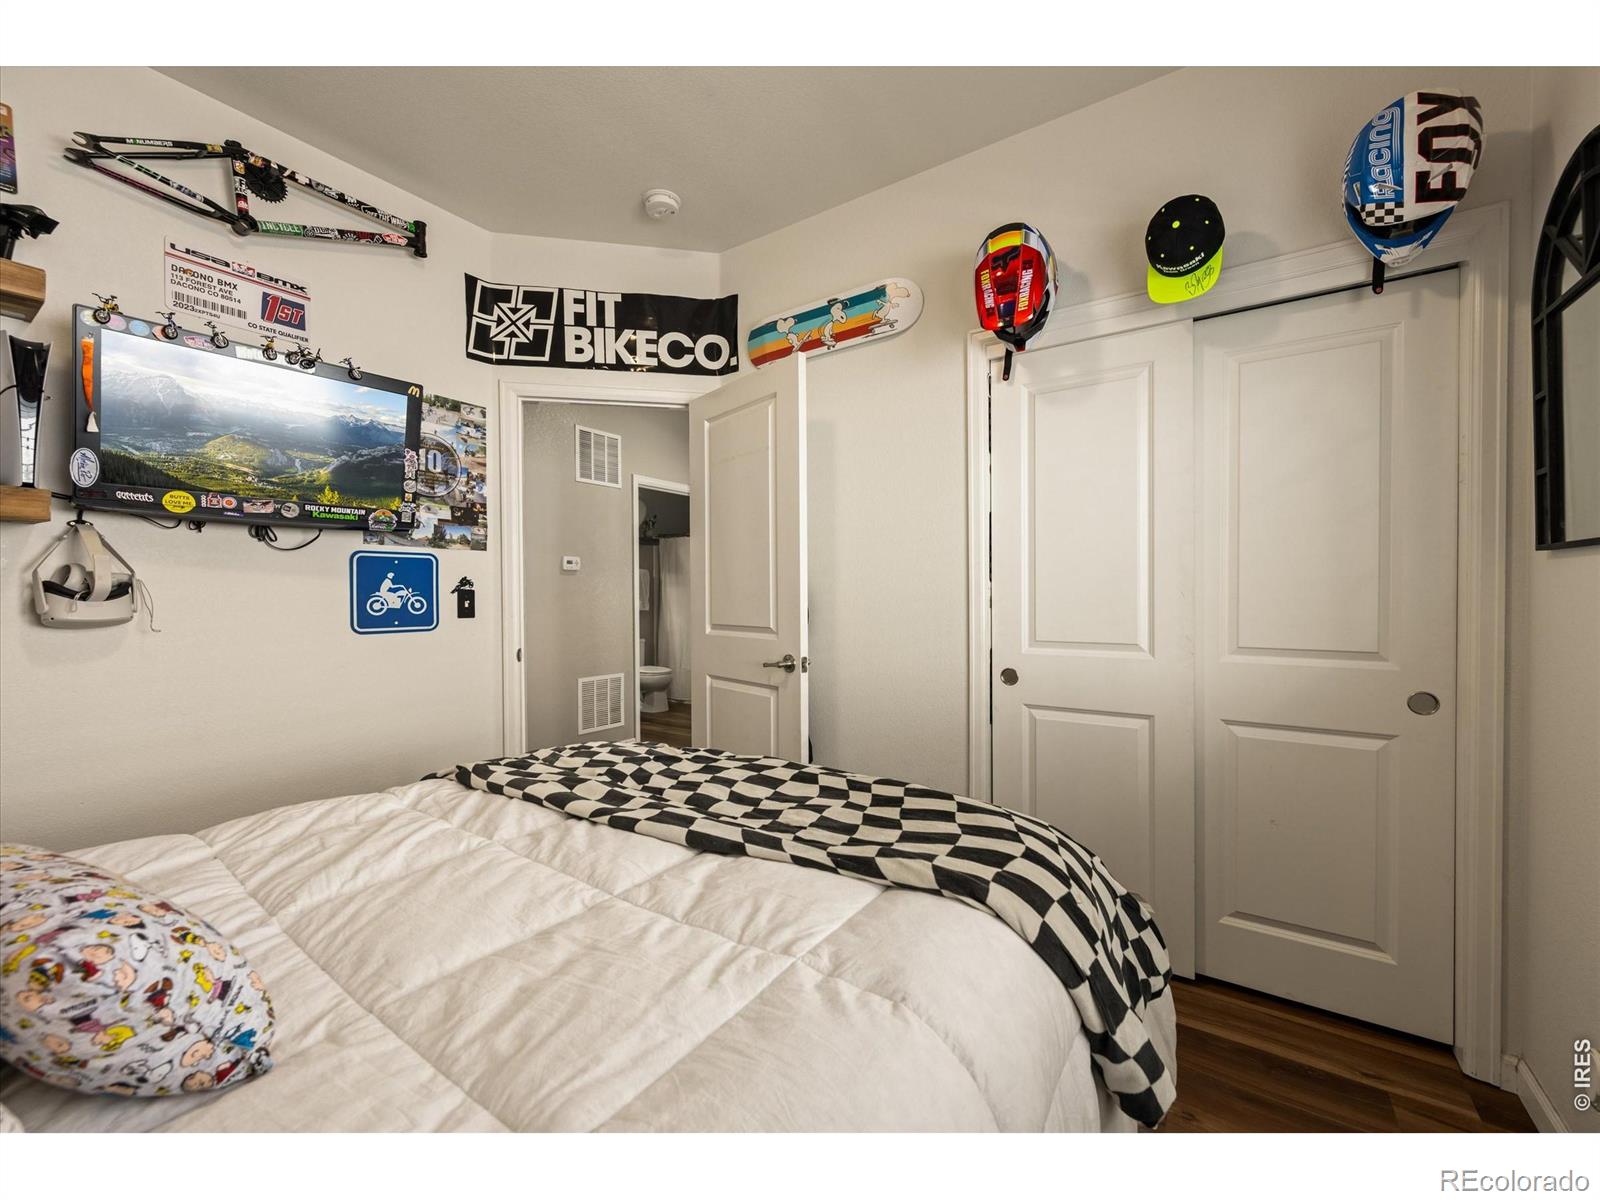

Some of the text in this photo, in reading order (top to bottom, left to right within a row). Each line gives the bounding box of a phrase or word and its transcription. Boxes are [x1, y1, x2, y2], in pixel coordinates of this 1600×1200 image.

[1415, 92, 1484, 204] FOX
[170, 263, 239, 291] DAONO BMX
[170, 272, 233, 296] 113 FOREST AVE
[170, 278, 242, 304] DACONO CO 80514
[172, 300, 195, 312] 2023
[263, 294, 304, 325] 1ST
[563, 288, 622, 327] FIT
[247, 321, 309, 343] CO STATE QUALIFIER
[304, 504, 330, 513] ROCKY
[330, 506, 366, 516] MOUNTAIN
[312, 511, 359, 521] Kawasaki
